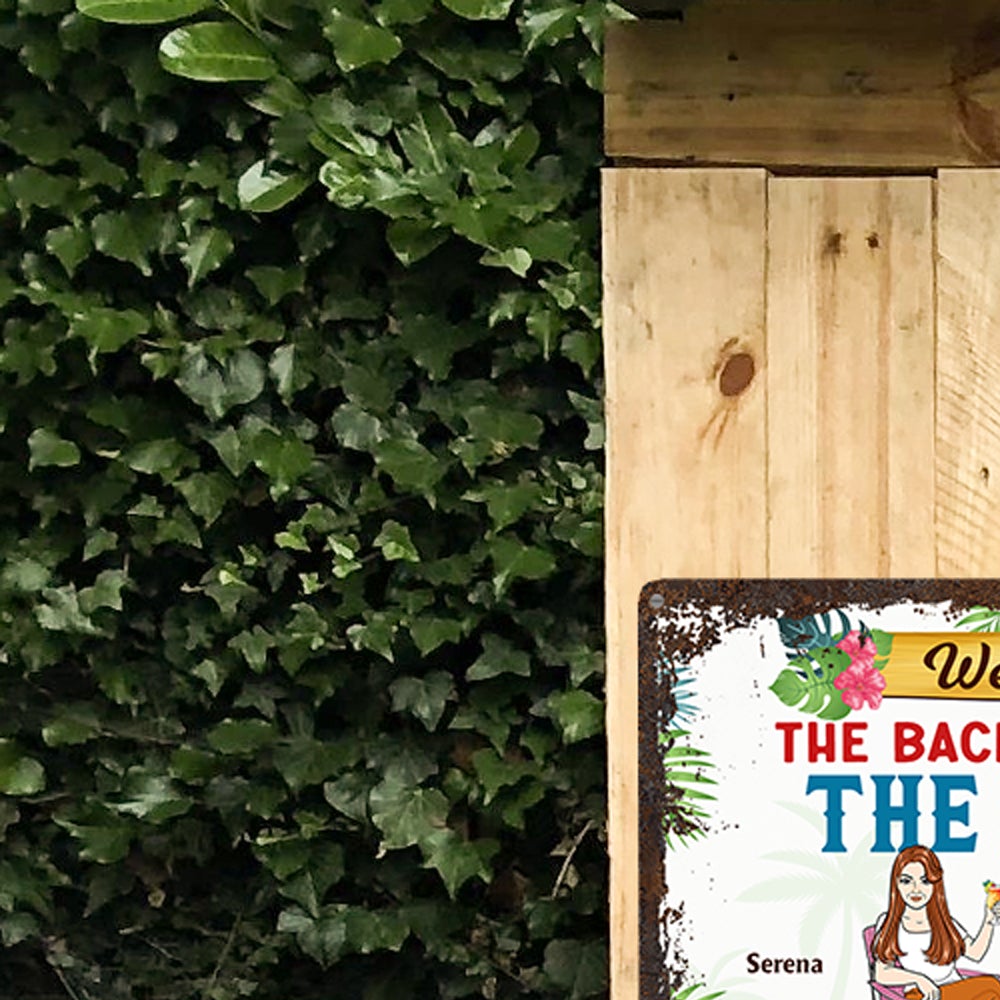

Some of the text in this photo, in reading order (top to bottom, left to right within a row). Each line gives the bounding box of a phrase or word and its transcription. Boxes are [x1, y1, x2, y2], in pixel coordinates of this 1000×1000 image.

[775, 721, 869, 763] THE
[805, 774, 978, 853] THE
[746, 952, 823, 975] Serena
